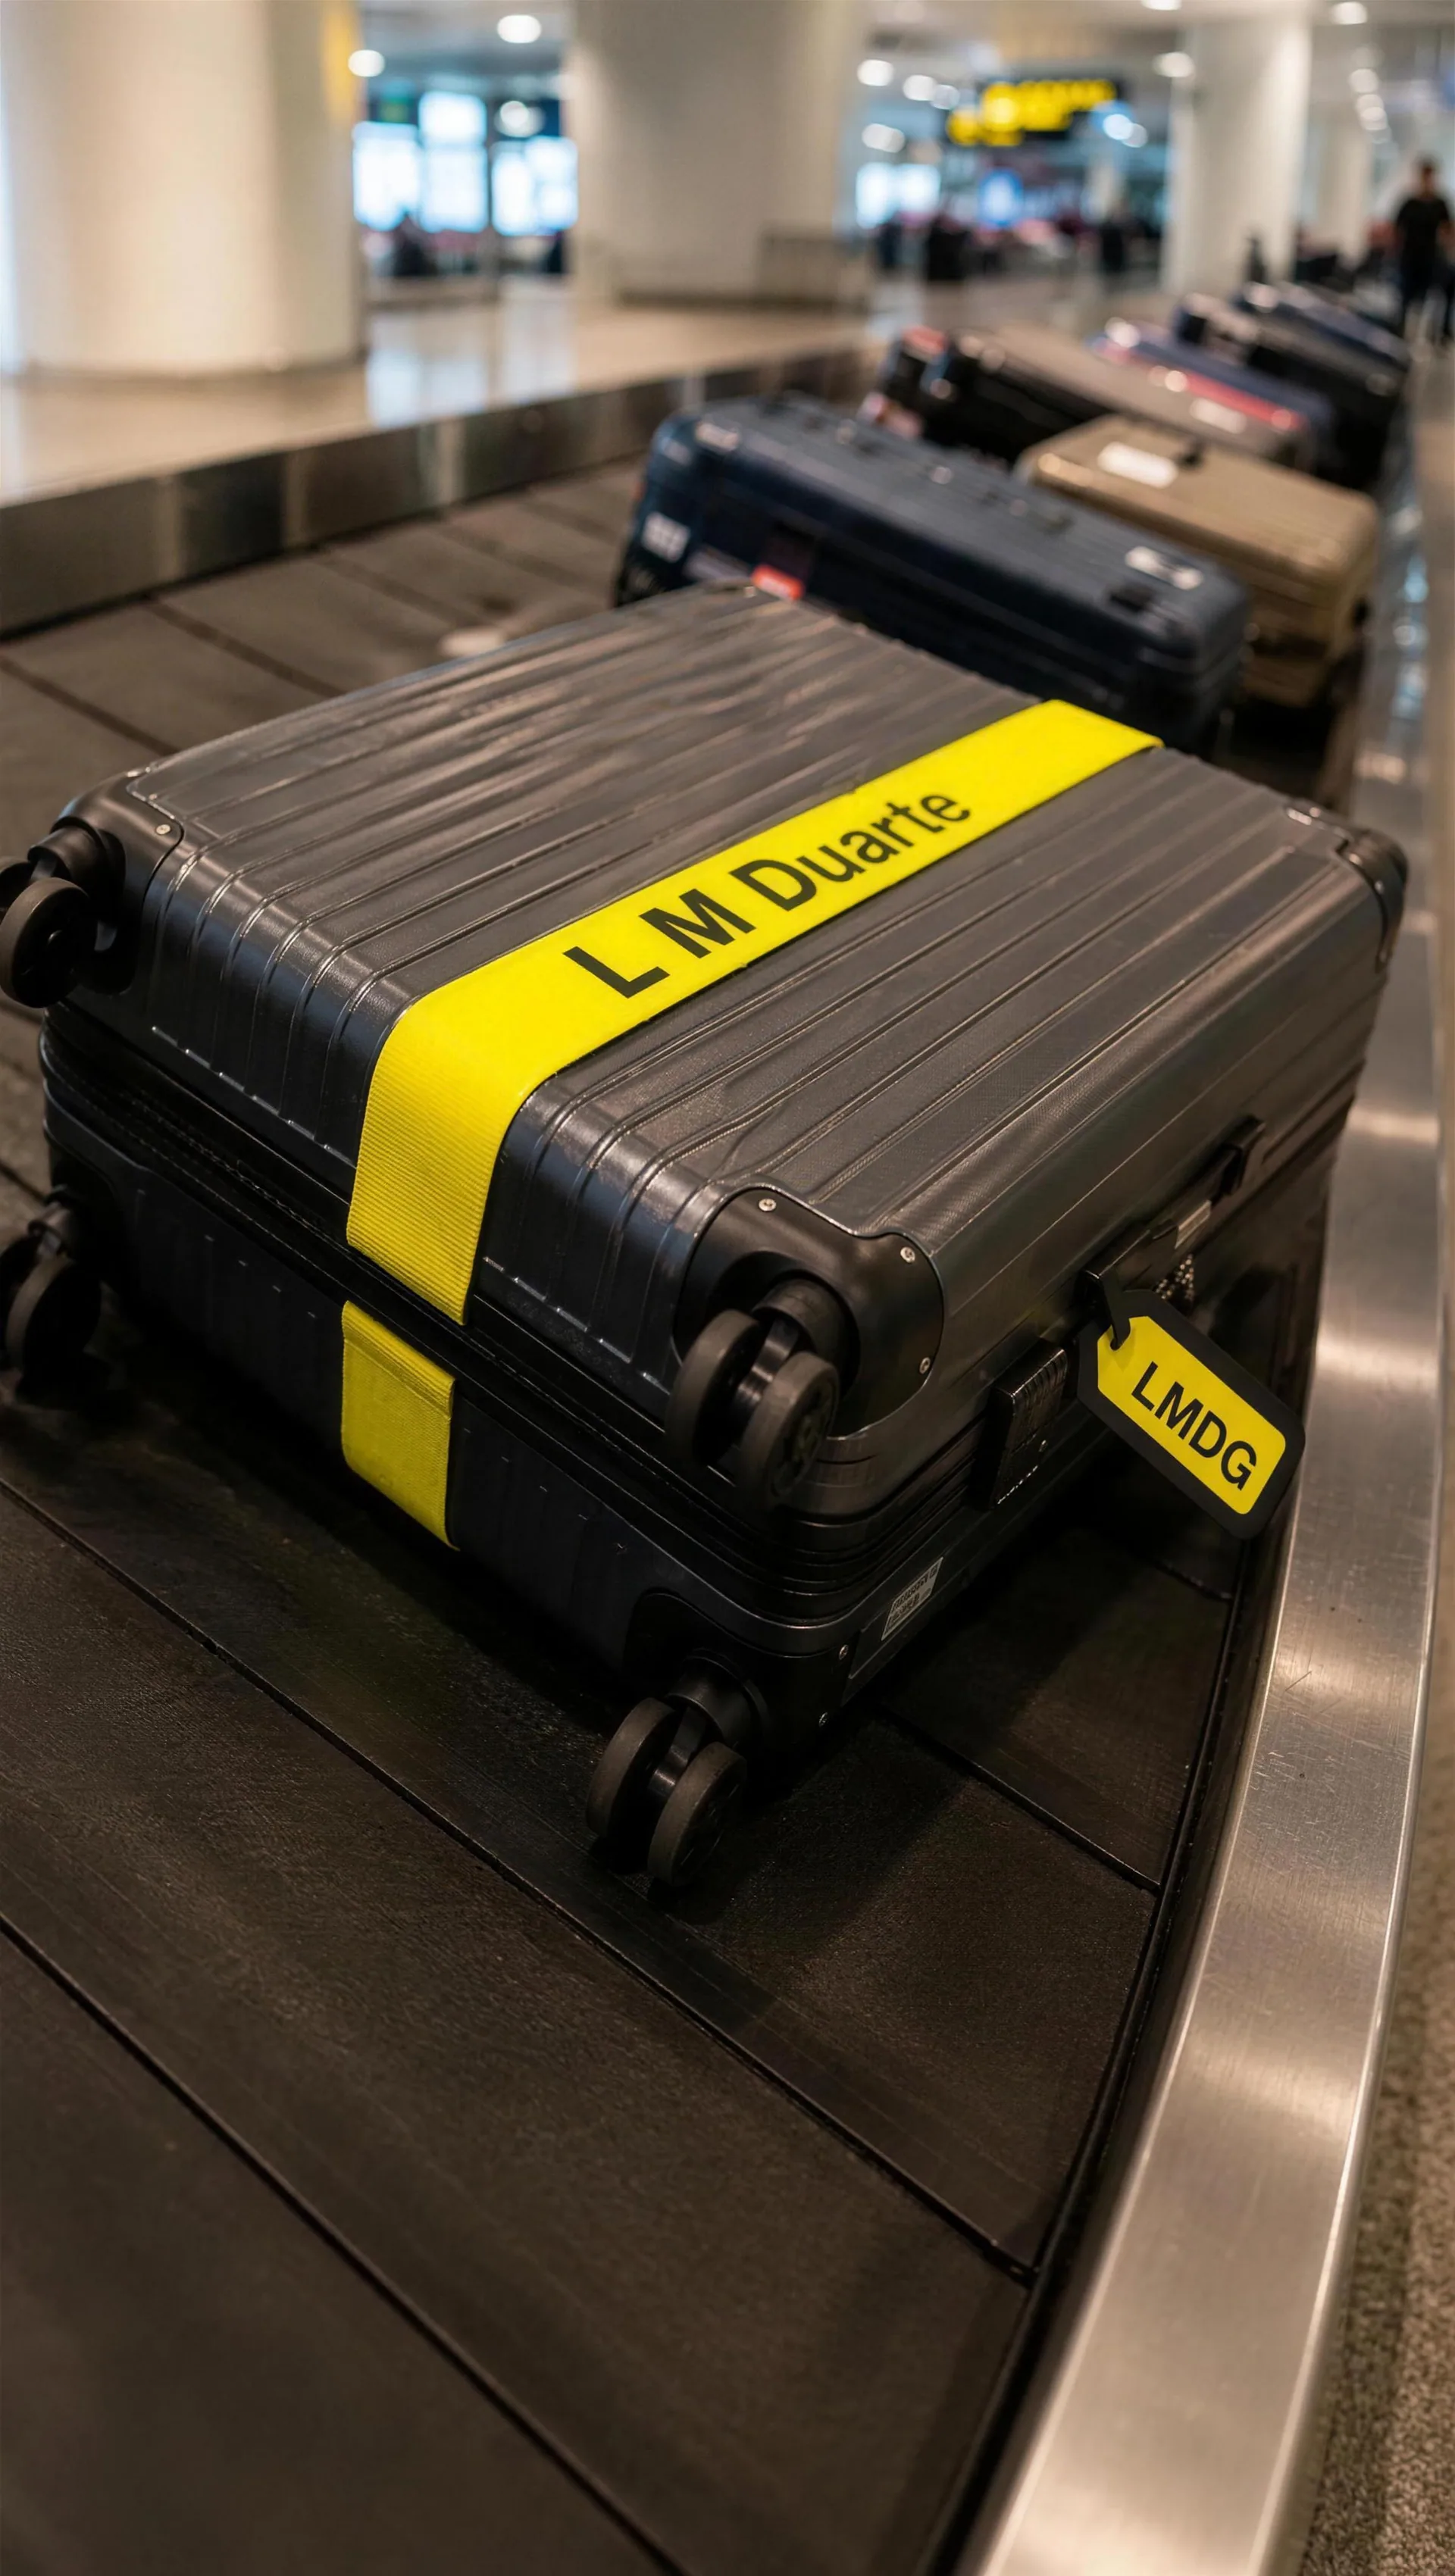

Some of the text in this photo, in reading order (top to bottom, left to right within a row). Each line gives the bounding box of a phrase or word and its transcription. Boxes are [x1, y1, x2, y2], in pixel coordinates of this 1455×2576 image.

[563, 795, 971, 999] L M Duarte
[1131, 1361, 1257, 1491] LMDG
